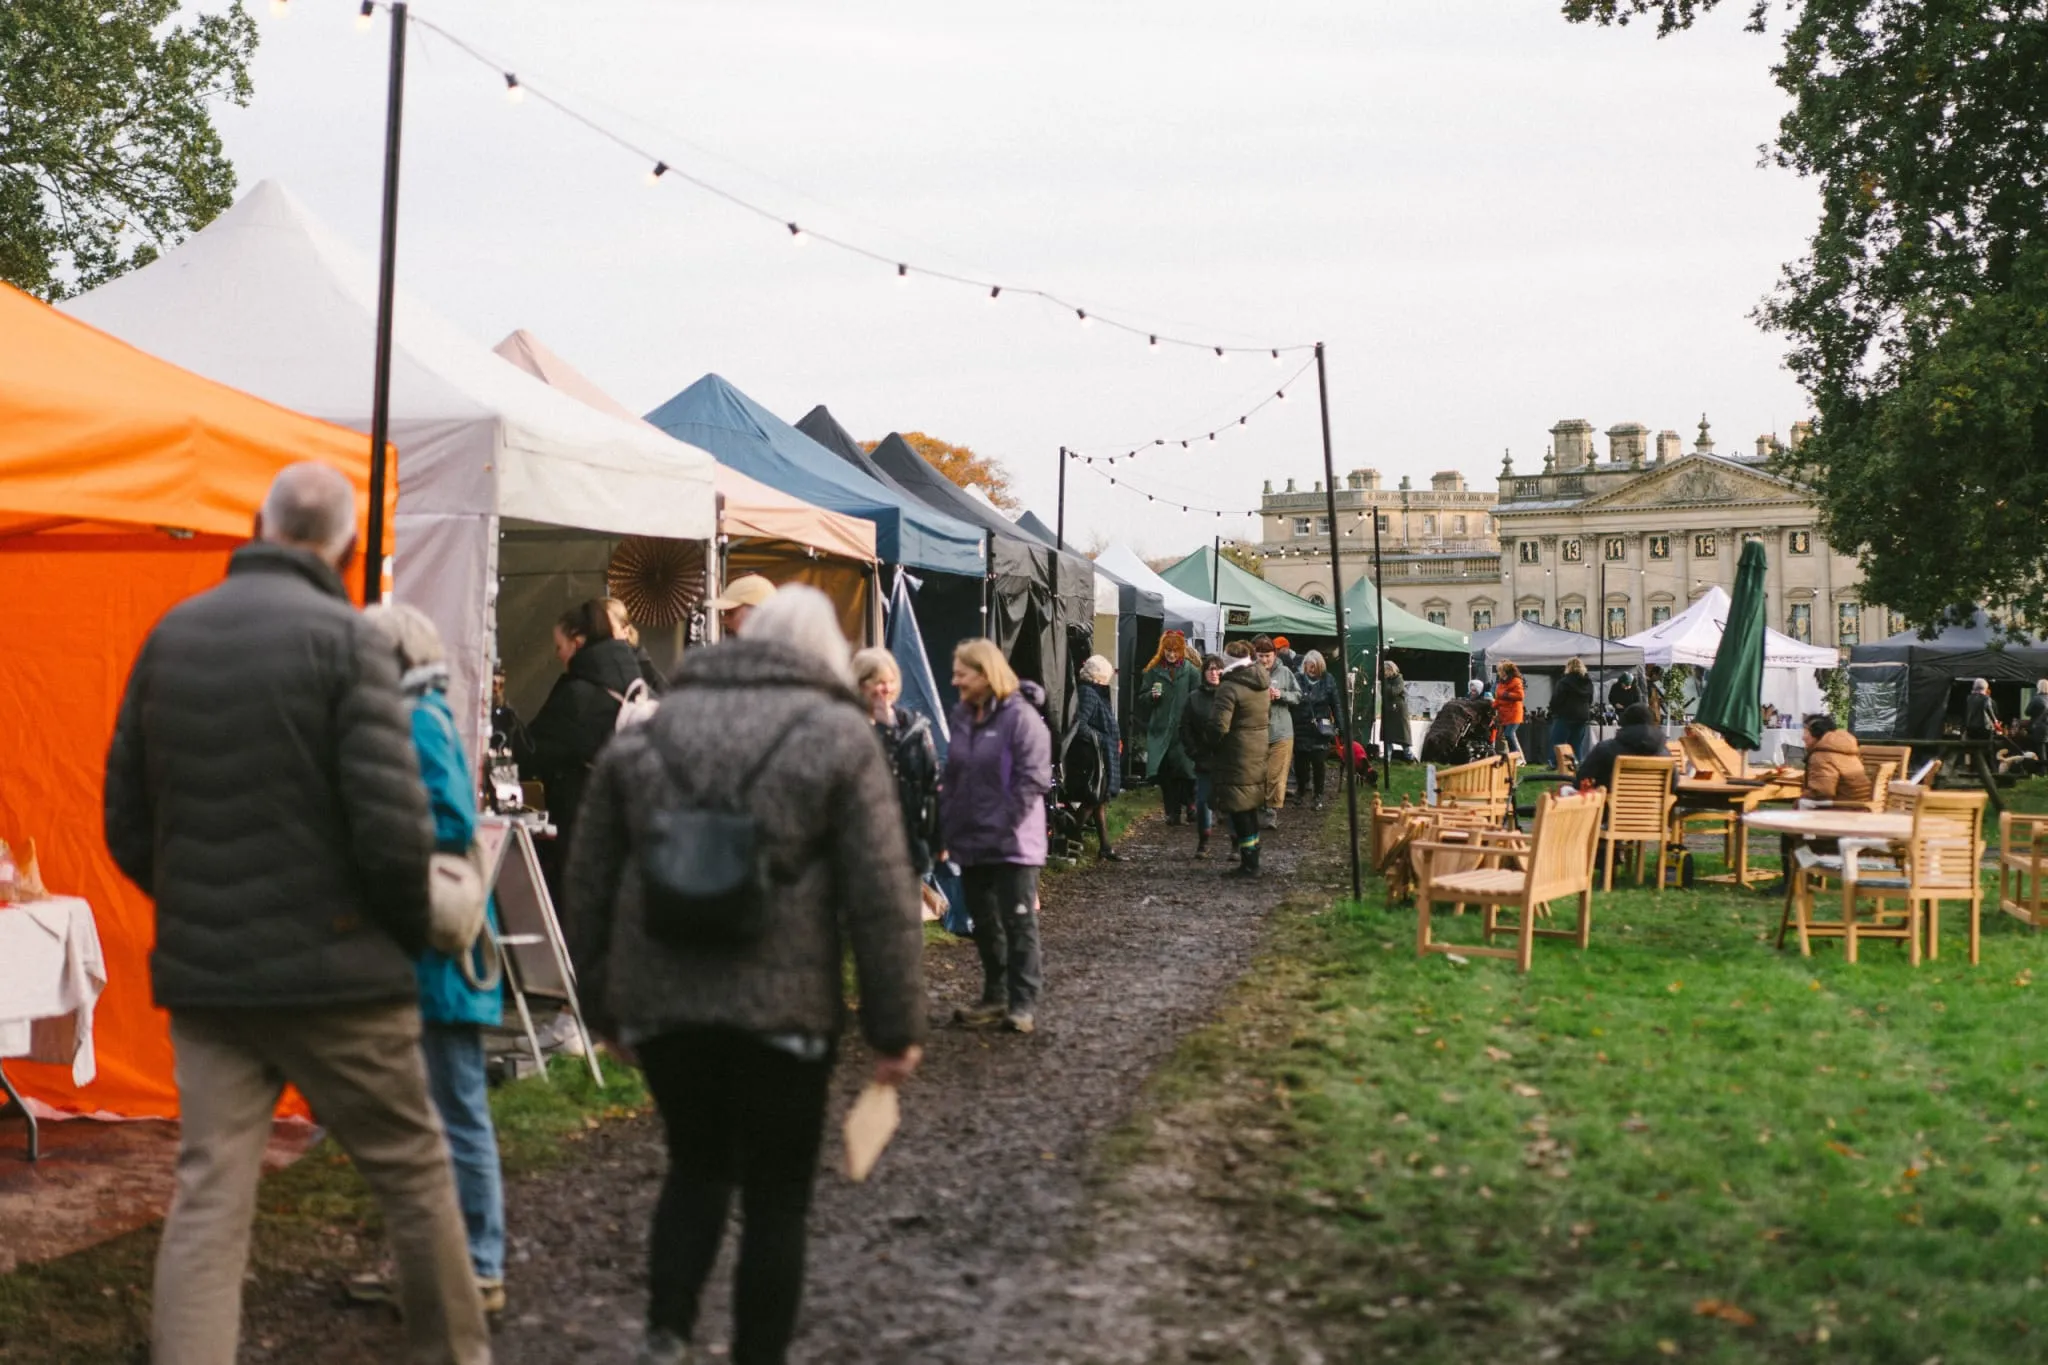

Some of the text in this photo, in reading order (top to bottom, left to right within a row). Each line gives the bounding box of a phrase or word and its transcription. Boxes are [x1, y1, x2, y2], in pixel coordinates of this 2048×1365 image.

[1526, 542, 1533, 560] 1
[1566, 540, 1580, 559] 13
[1608, 540, 1622, 557] 11
[1654, 538, 1664, 556] 4
[1795, 533, 1805, 552] 8
